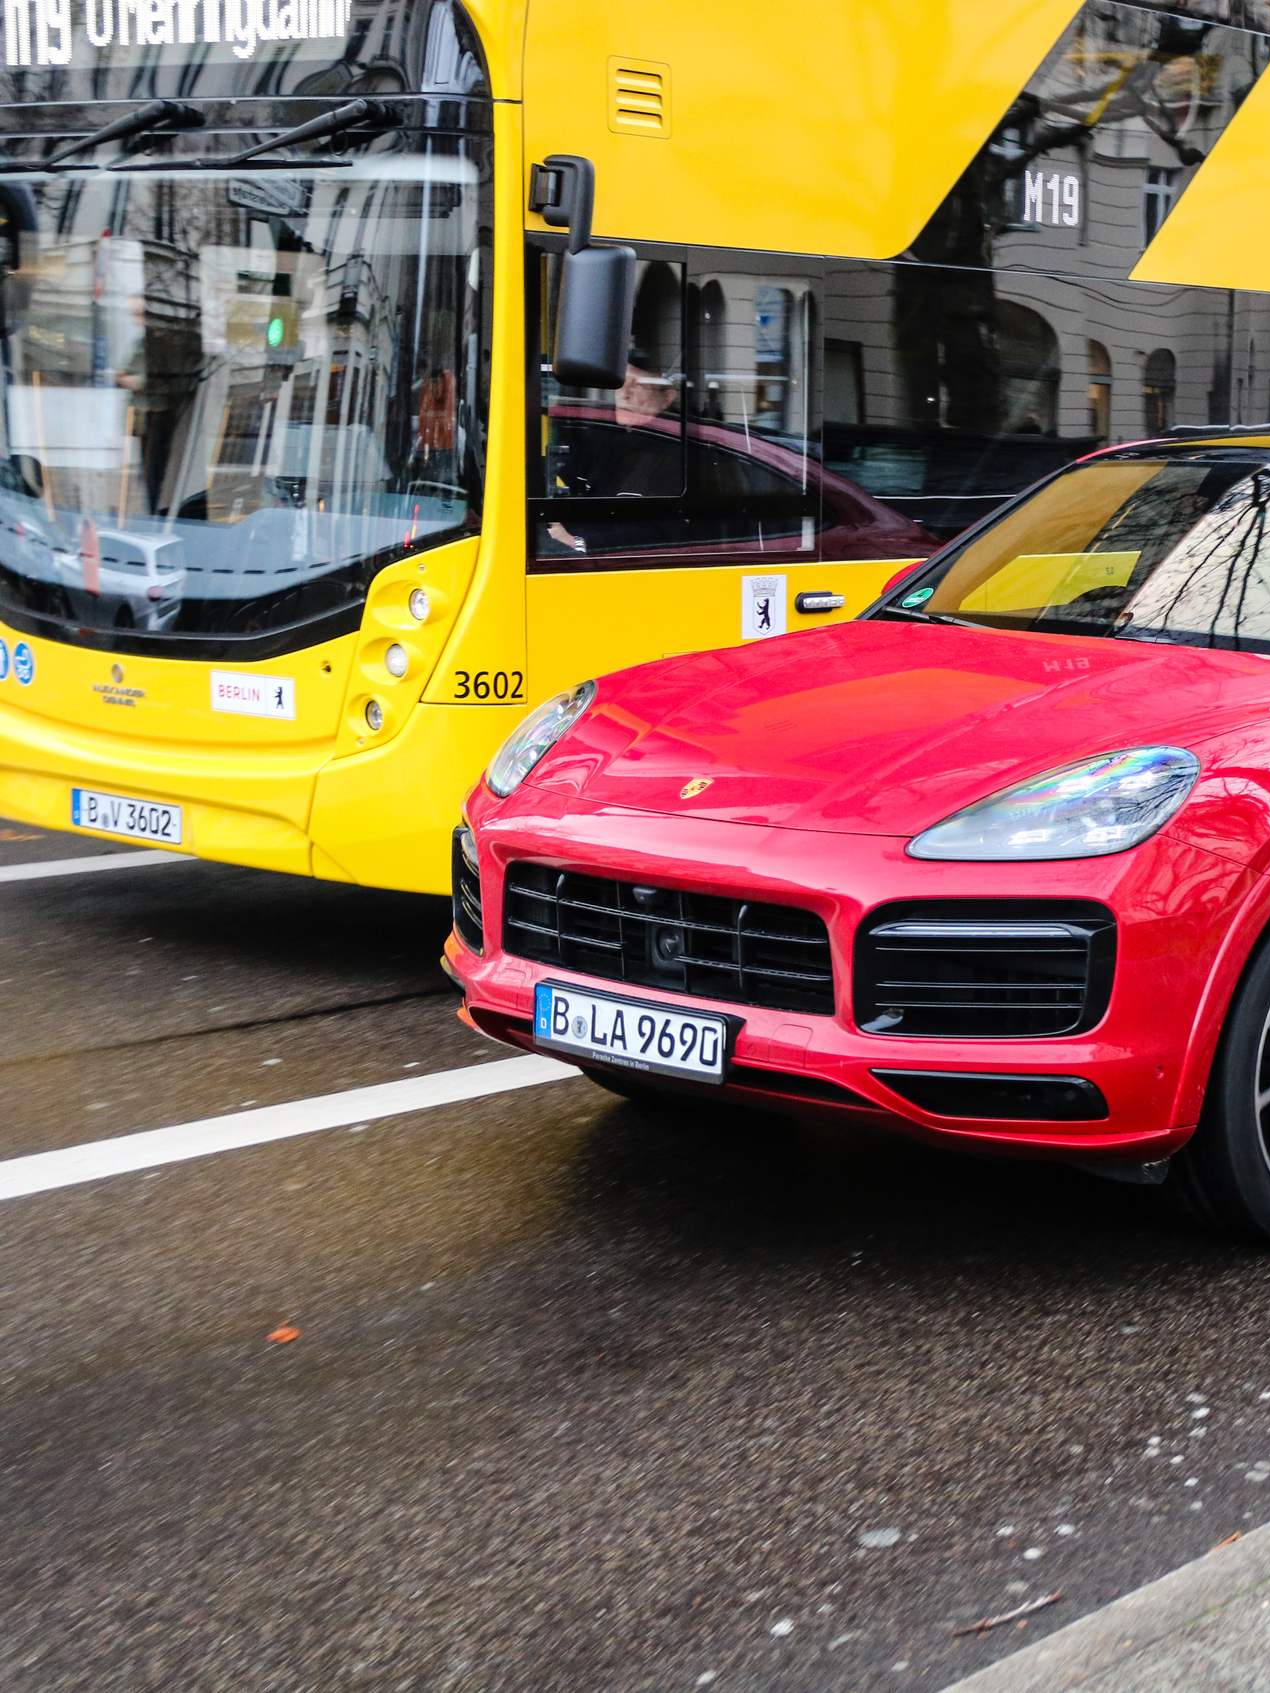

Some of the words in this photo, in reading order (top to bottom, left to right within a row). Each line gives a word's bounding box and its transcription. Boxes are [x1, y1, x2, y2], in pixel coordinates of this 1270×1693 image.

[1024, 170, 1079, 226] M19
[218, 684, 260, 701] BERLIN
[454, 671, 523, 699] 3602
[88, 797, 98, 823] B
[111, 801, 121, 827] V
[126, 804, 172, 837] 3602
[540, 1017, 547, 1029] D
[553, 996, 569, 1036] B
[591, 1003, 628, 1050] LA
[638, 1014, 718, 1067] 9690
